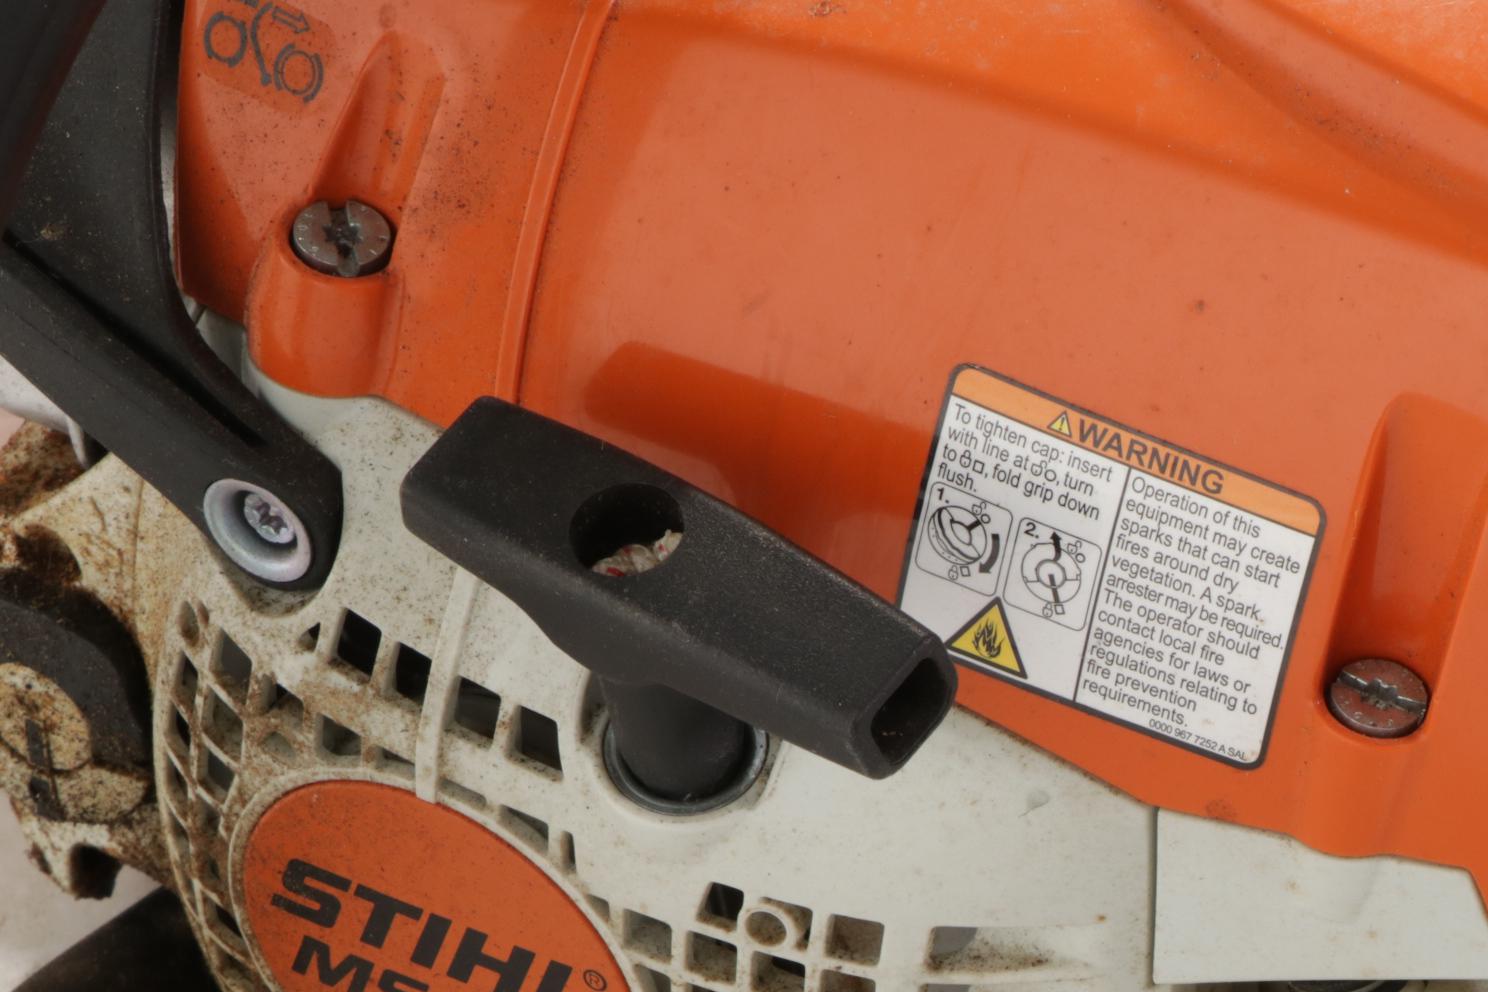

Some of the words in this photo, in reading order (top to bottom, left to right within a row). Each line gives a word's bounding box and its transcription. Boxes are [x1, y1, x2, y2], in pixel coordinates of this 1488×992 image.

[948, 426, 977, 449] with
[981, 436, 1009, 462] line
[1012, 454, 1029, 470] at
[1063, 471, 1093, 496] turn
[955, 402, 971, 424] To
[975, 414, 1026, 447] tighten
[1031, 440, 1064, 463] cap:
[1067, 450, 1112, 482] insert
[1079, 419, 1222, 493] WARNING
[937, 462, 976, 491] flush.
[937, 487, 949, 503] 1.
[942, 443, 957, 461] to
[992, 463, 1021, 488] fold
[1023, 480, 1053, 502] grip
[1057, 492, 1099, 519] down
[1131, 476, 1208, 517] Operation
[1211, 505, 1231, 527] of
[1232, 515, 1260, 538] this
[1023, 521, 1038, 538] 2.
[1120, 518, 1172, 546] sparks
[1177, 536, 1207, 560] that
[1211, 552, 1239, 572] can
[1244, 564, 1280, 587] start
[1125, 499, 1208, 539] equipment
[1212, 531, 1246, 556] may
[1250, 546, 1300, 573] create
[1112, 555, 1194, 596] vegetation.
[1199, 586, 1211, 603] A
[1115, 533, 1149, 558] fires
[1153, 551, 1209, 580] around
[1212, 571, 1238, 594] dry
[1098, 610, 1155, 640] contact
[1158, 629, 1196, 654] local
[1200, 644, 1224, 665] fire
[1104, 587, 1132, 611] The
[1136, 605, 1203, 640] operator
[1207, 630, 1260, 659] should
[1106, 574, 1163, 602] arrester
[1164, 595, 1197, 619] may
[1198, 604, 1218, 624] be
[1219, 616, 1282, 649] required.
[1086, 658, 1111, 679] fire
[1114, 672, 1196, 710] prevention
[1090, 642, 1174, 685] regulations
[1180, 678, 1237, 711] relating
[1242, 698, 1257, 714] to
[1093, 627, 1163, 662] agencies
[1168, 651, 1190, 670] for
[1193, 661, 1228, 686] laws
[1233, 679, 1251, 693] or
[1082, 679, 1186, 731] requirements.
[1148, 718, 1172, 733] 0000
[1174, 727, 1192, 740] 967
[1194, 734, 1217, 750] 7252
[1217, 744, 1225, 753] A
[1227, 747, 1247, 762] SAL
